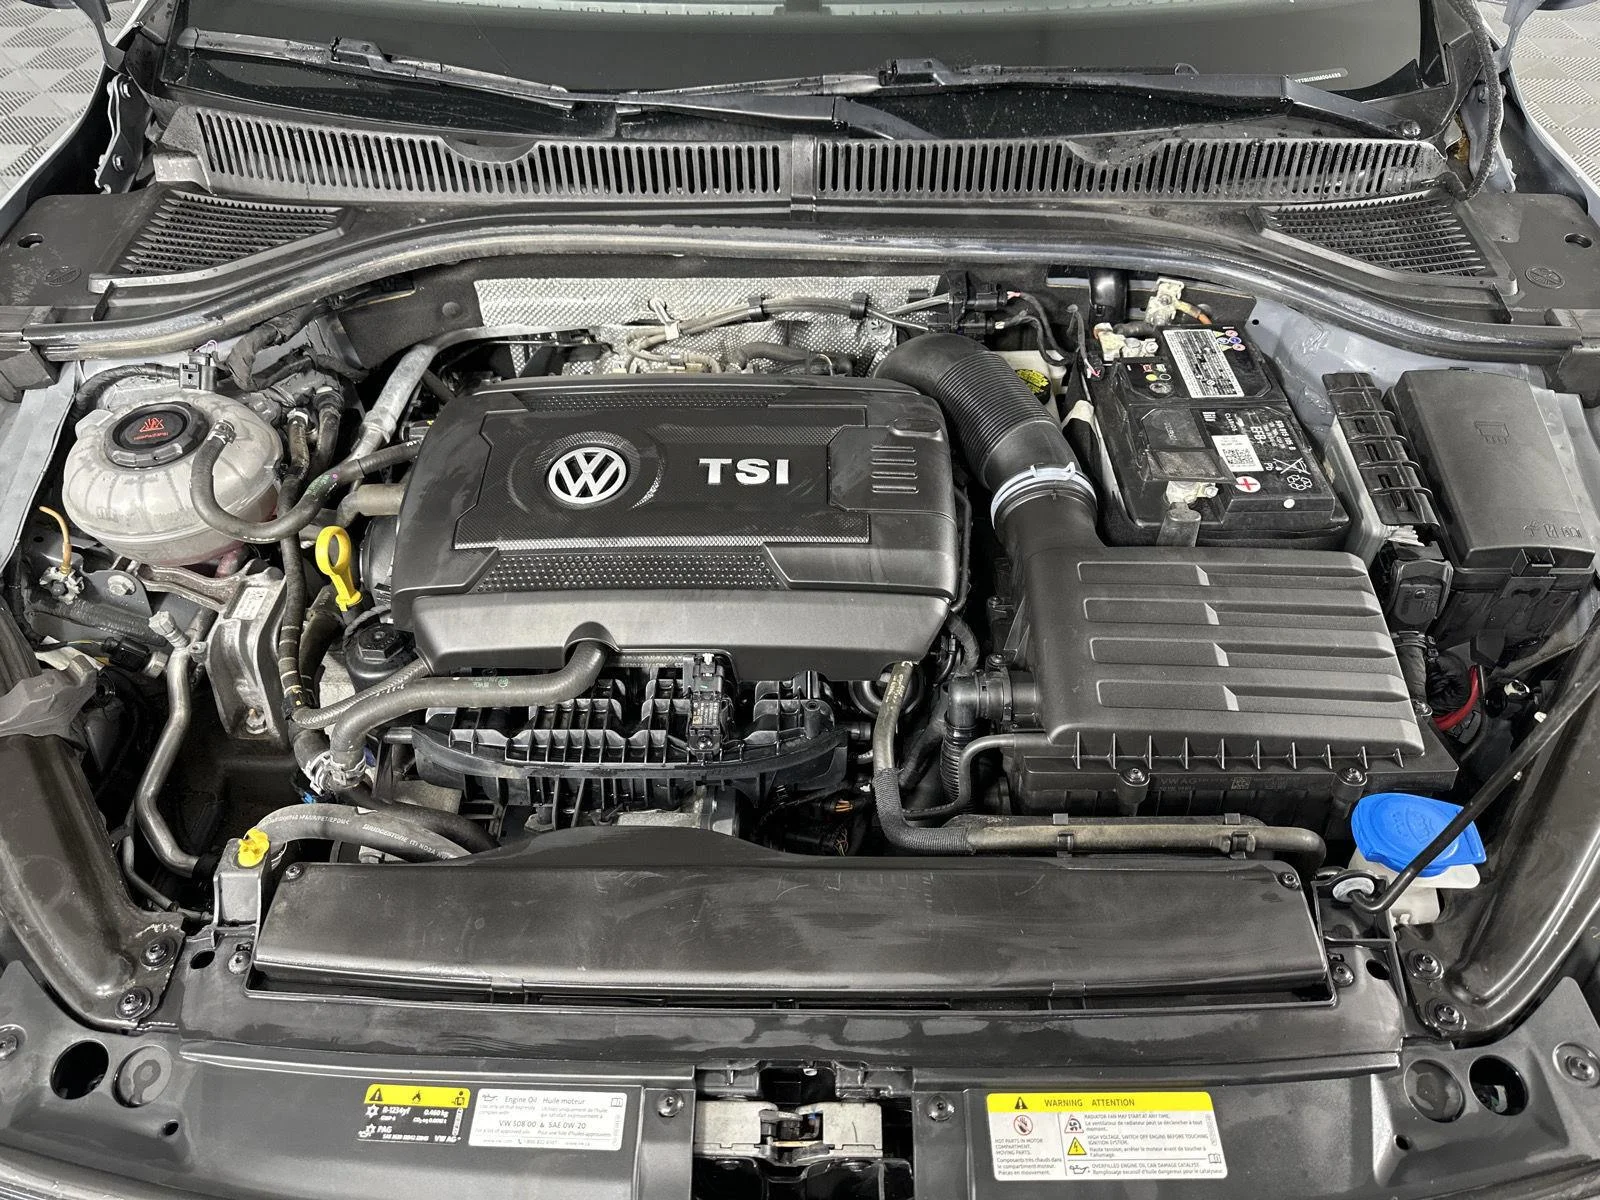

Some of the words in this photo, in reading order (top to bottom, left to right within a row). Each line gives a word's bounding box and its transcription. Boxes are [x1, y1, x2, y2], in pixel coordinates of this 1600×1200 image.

[1264, 462, 1274, 470] Pb
[698, 458, 789, 485] TSI
[504, 1096, 526, 1104] Engine
[1044, 1099, 1083, 1107] WARNING
[513, 1120, 525, 1128] 508
